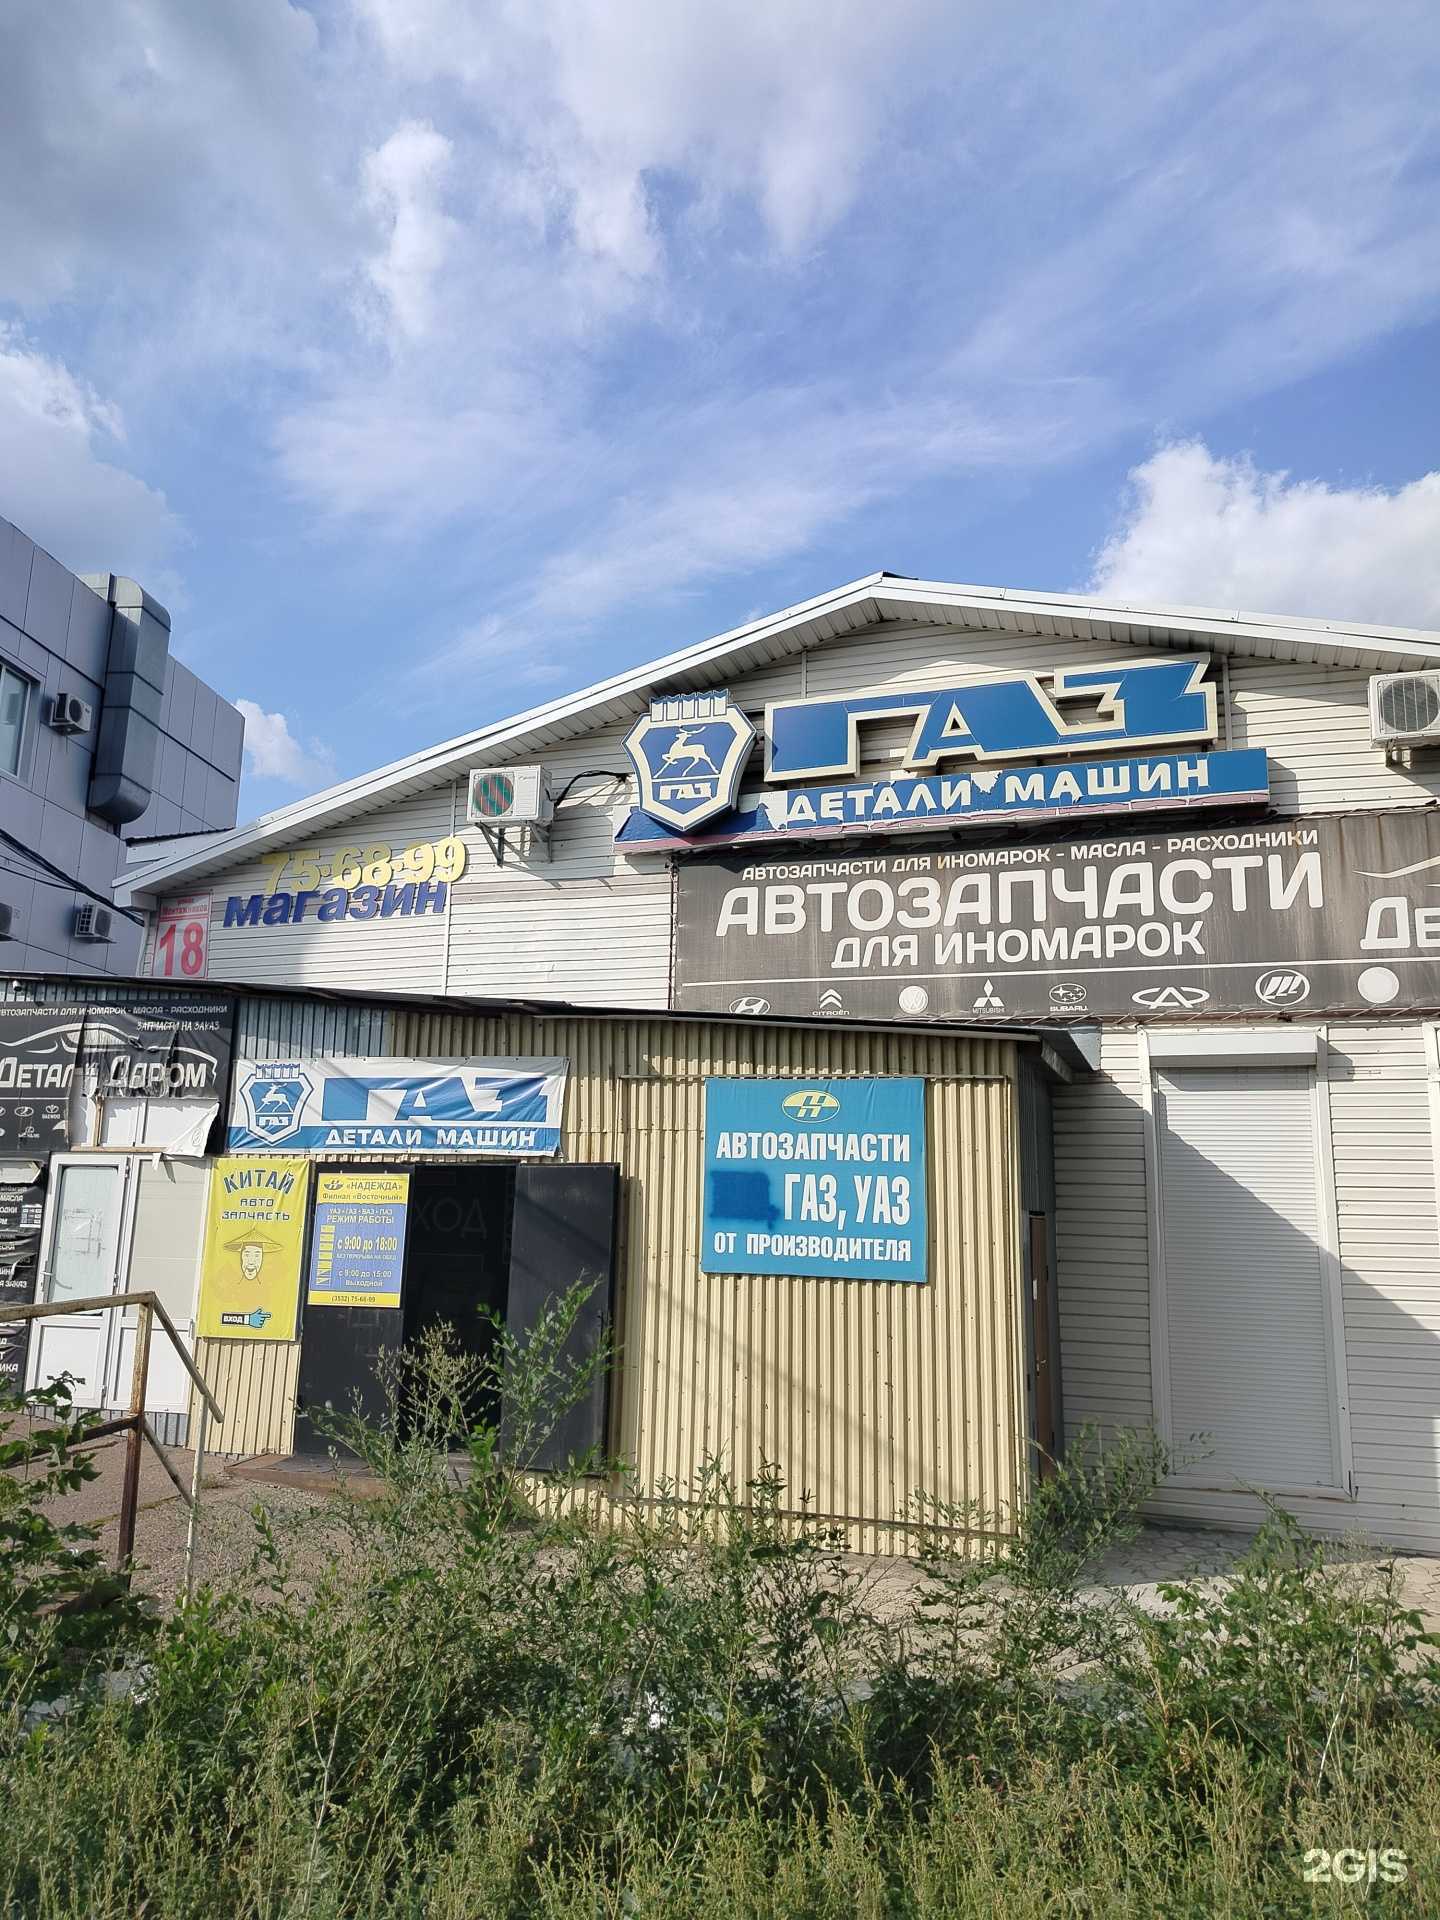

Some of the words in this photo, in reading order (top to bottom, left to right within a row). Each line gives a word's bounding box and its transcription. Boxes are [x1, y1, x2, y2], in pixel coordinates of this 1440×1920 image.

[765, 654, 1217, 781] ГАЗ
[659, 783, 713, 800] ГАЗ
[787, 780, 971, 820] ДЕТАЛИ
[1003, 758, 1209, 803] МАШИН
[742, 859, 886, 881] АВТОЗАПЧАСТИ
[892, 856, 931, 873] ДЛЯ
[937, 846, 1050, 870] ИНОМАРОК
[1070, 840, 1146, 860] МАСЛА
[1167, 829, 1318, 853] РАСХОДНИКИ
[716, 851, 1324, 937] АВТОЗАПЧАСТИ
[159, 922, 204, 976] 18
[831, 933, 918, 970] ДЛЯ
[934, 919, 1206, 963] ИНОМАРОК
[0, 1007, 58, 1017] ВТОЗАПЧАСТИ
[60, 1007, 77, 1016] ДЛЯ
[132, 1006, 163, 1014] МАСЛА
[170, 1005, 228, 1014] РАСХОДНИКИ
[324, 1127, 421, 1146] ДЕТАЛИ
[436, 1128, 536, 1148] МАШИН
[716, 1131, 911, 1162] АВТОЗАПЧАСТИ
[223, 1169, 295, 1195] КИТАЙ
[222, 1211, 290, 1221] ЗАПЧАСТЬ
[239, 1198, 275, 1207] АВТО
[784, 1172, 847, 1231] ГАЗ,
[853, 1175, 911, 1225] УАЗ
[344, 1236, 361, 1250] 9:00
[363, 1240, 373, 1253] до
[376, 1237, 398, 1251] 18:00
[714, 1232, 737, 1253] ОТ
[746, 1233, 912, 1262] ПРОИЗВОДИТЕЛЯ
